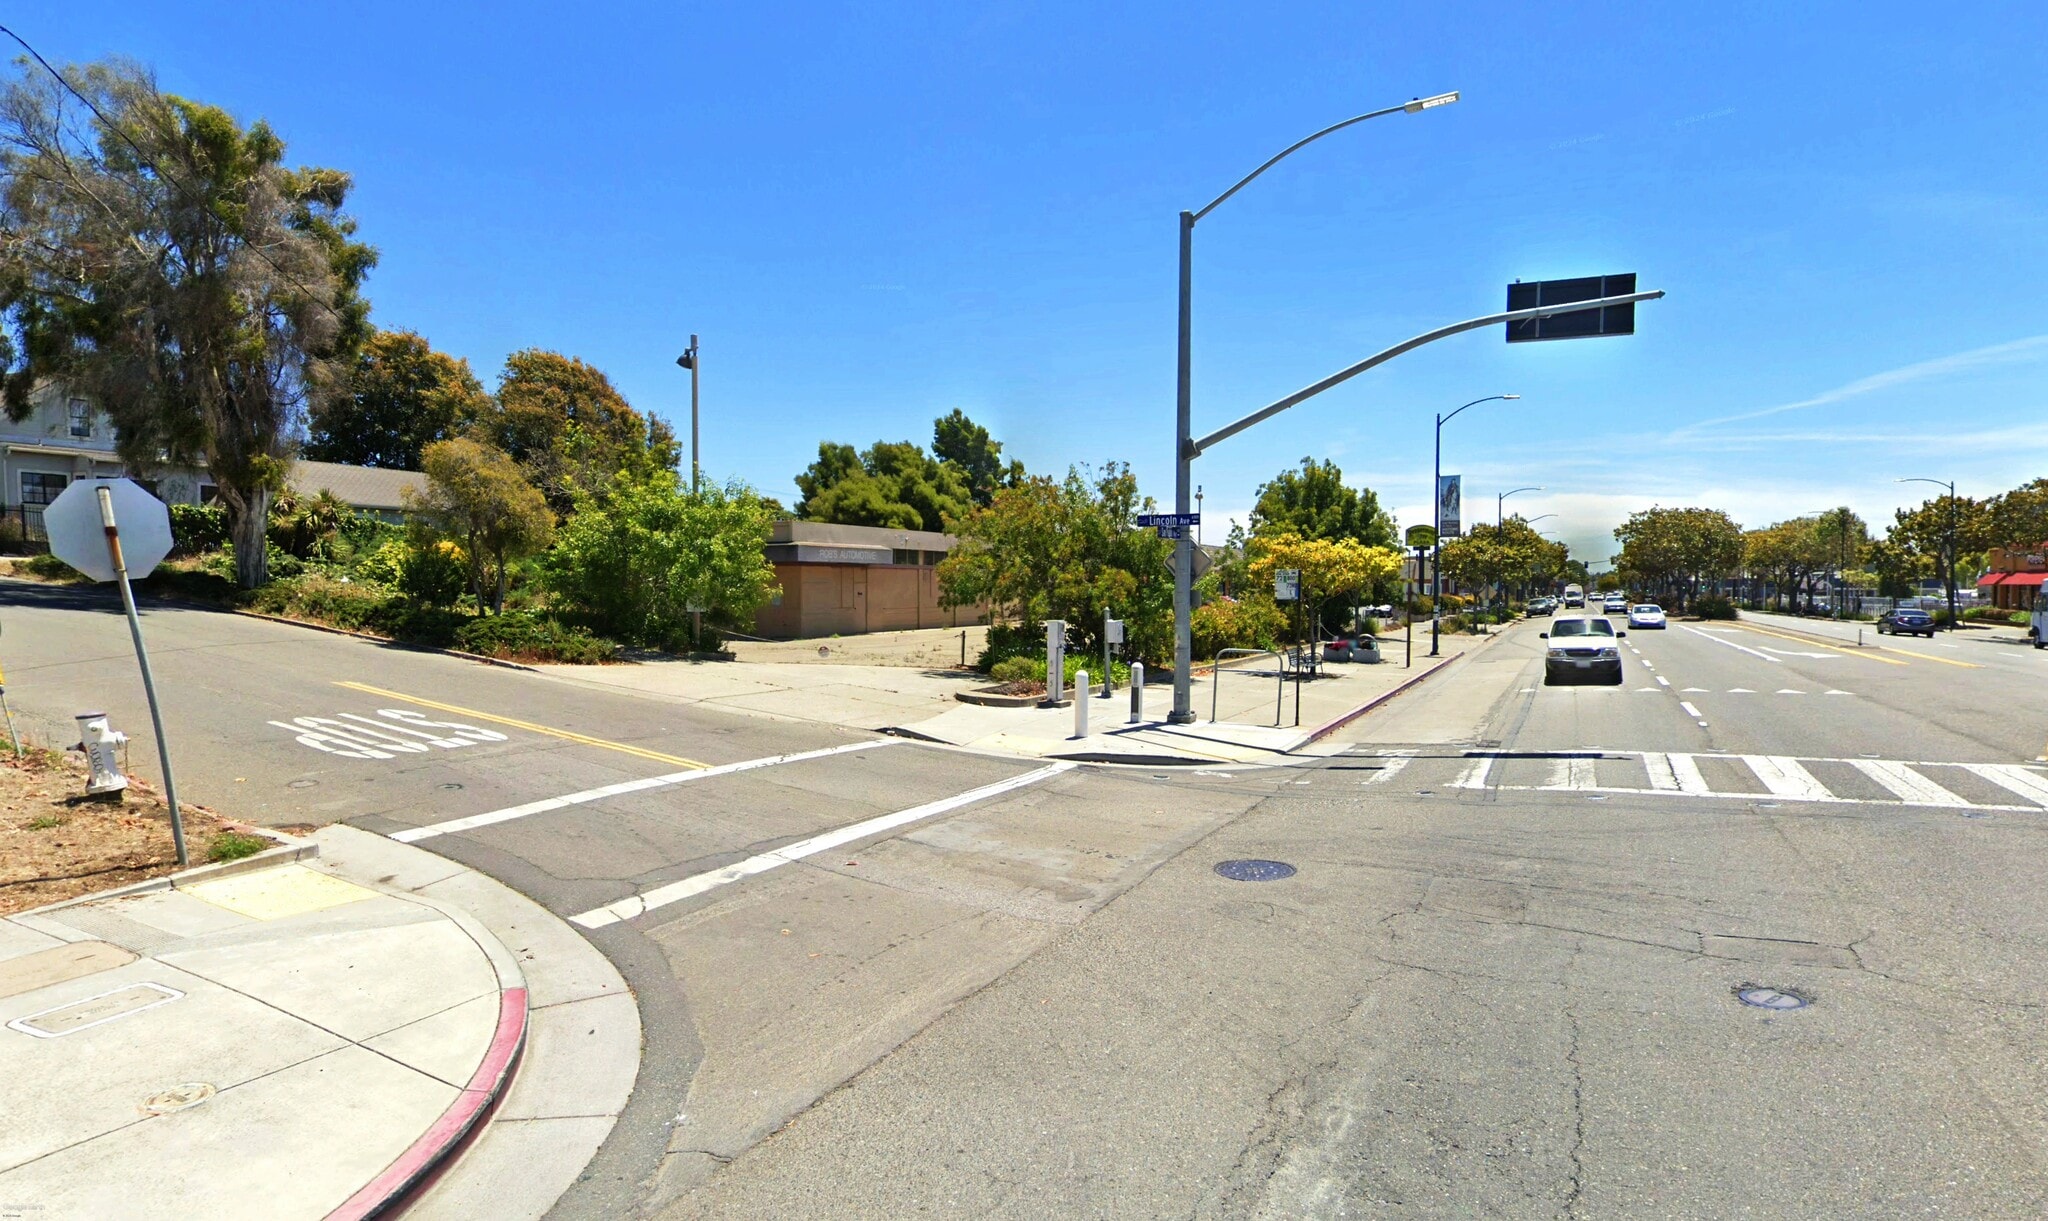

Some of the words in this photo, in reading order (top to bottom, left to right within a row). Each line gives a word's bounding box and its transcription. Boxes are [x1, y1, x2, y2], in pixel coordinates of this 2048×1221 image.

[1149, 515, 1178, 526] Lincoln
[1179, 517, 1190, 525] Ave
[839, 550, 878, 561] AUTOMOTIVE
[267, 708, 508, 759] STOP
